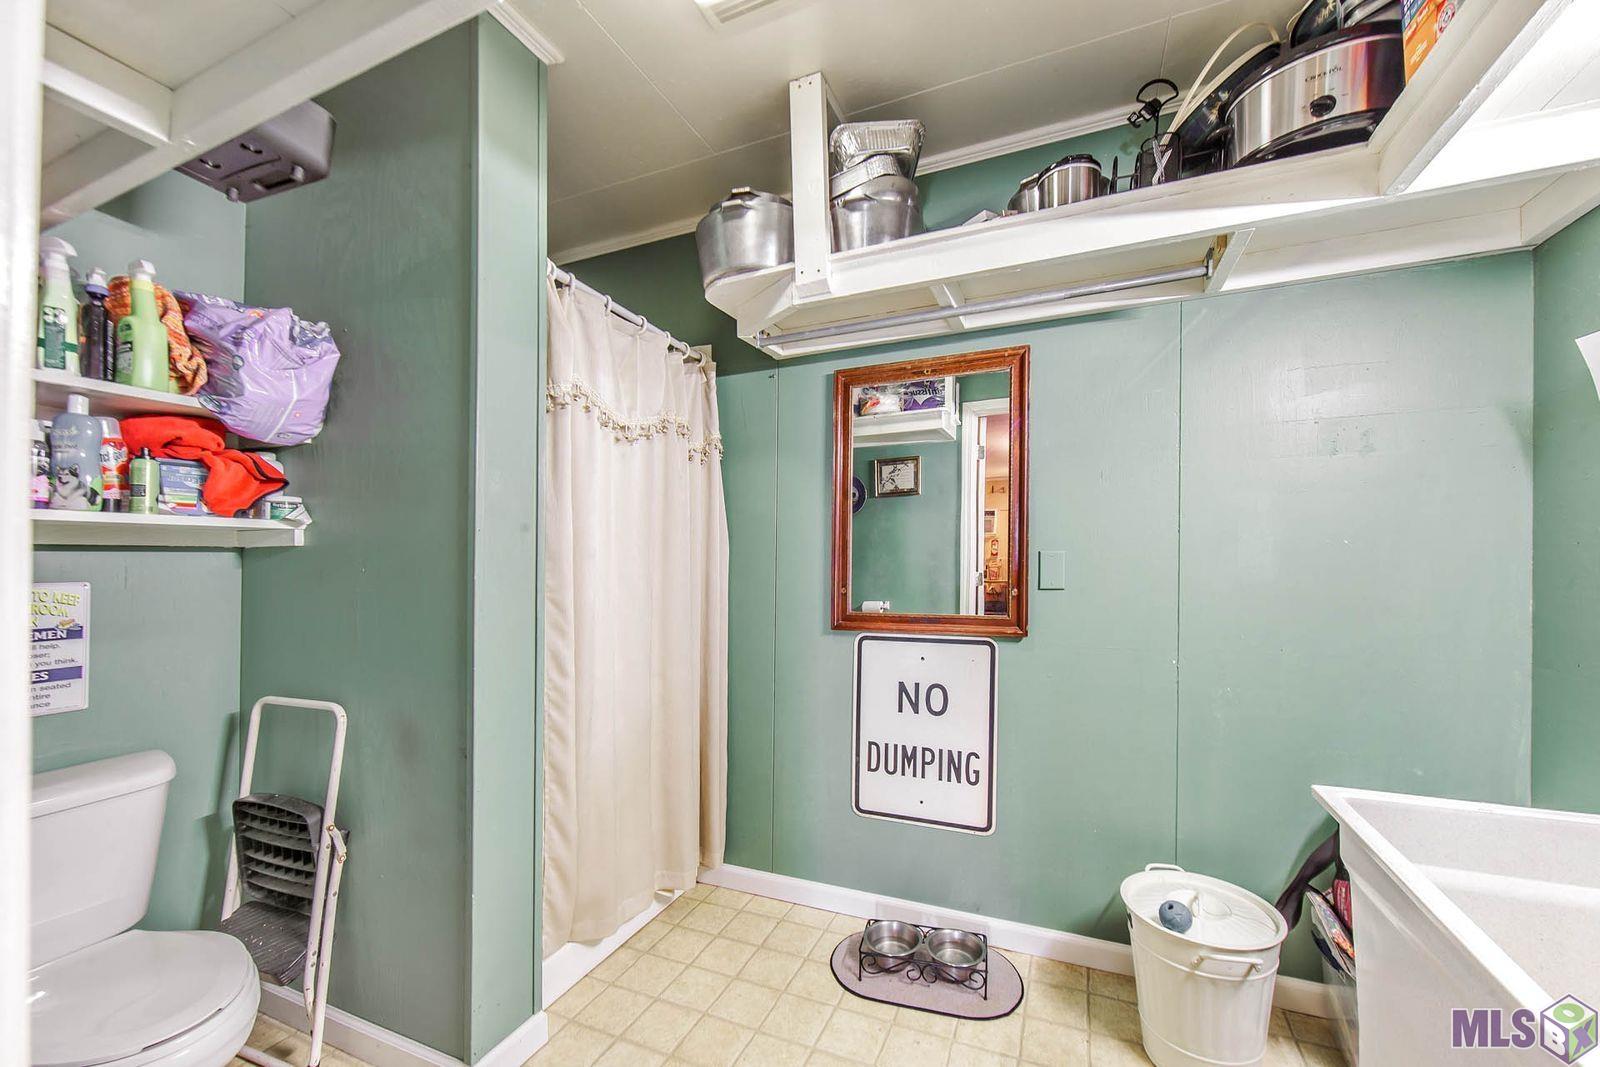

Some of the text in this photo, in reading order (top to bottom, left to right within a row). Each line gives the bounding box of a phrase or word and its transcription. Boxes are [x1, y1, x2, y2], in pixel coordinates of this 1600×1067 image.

[32, 629, 68, 641] MEN
[39, 682, 72, 692] seated
[897, 681, 949, 717] NO
[866, 740, 981, 787] DUMPING
